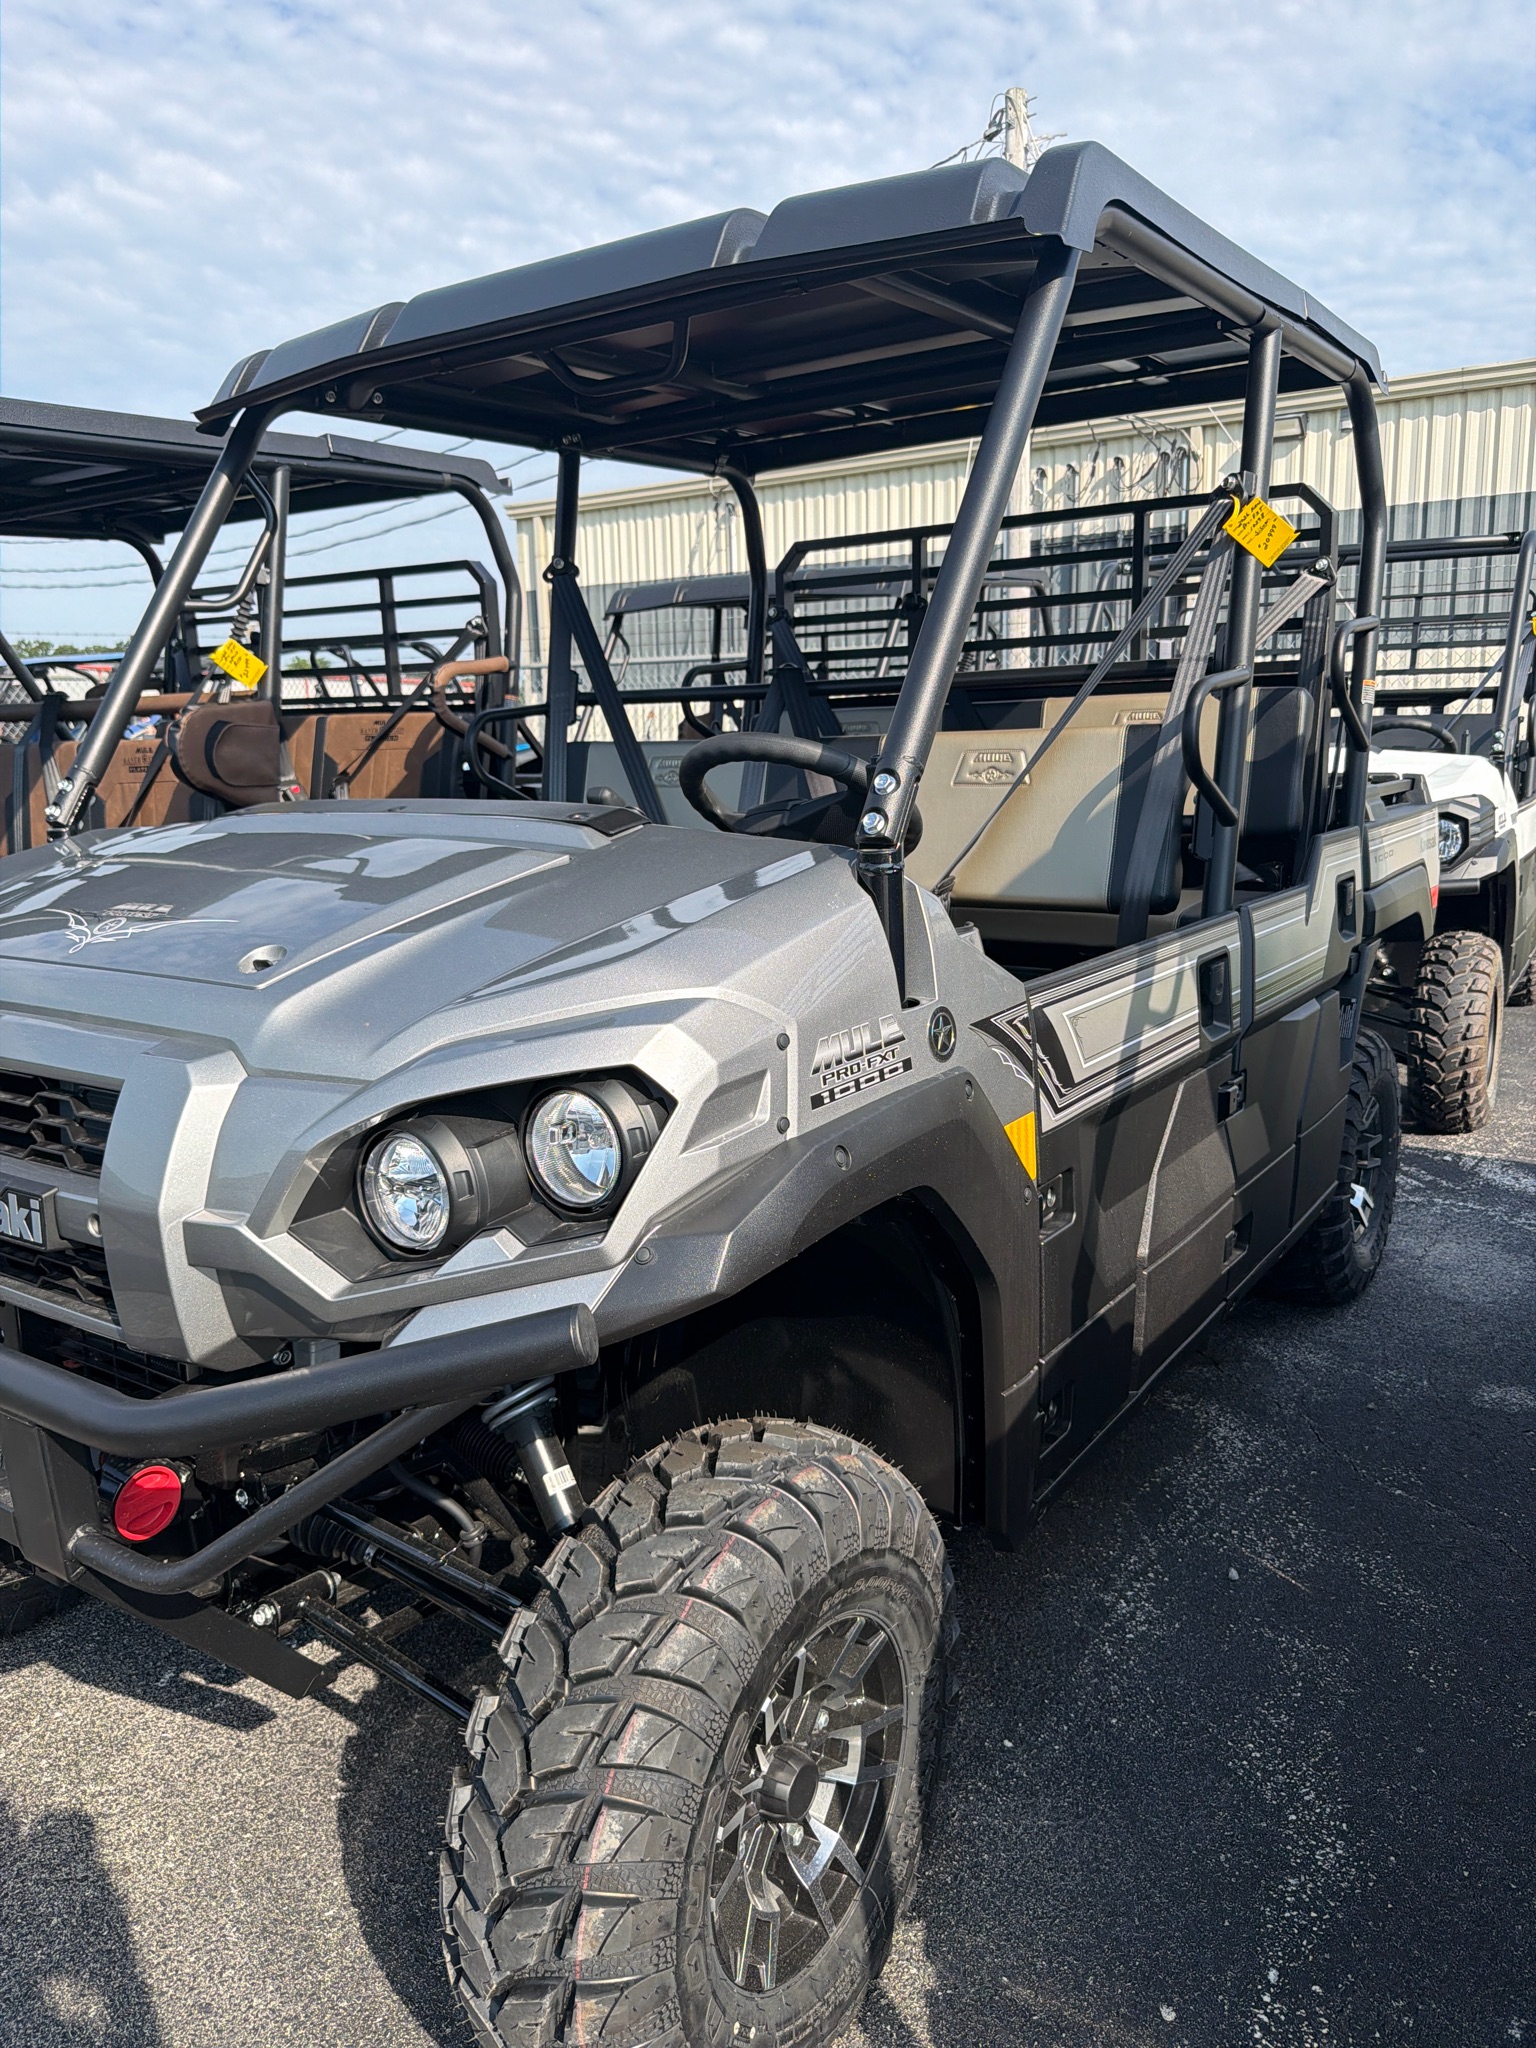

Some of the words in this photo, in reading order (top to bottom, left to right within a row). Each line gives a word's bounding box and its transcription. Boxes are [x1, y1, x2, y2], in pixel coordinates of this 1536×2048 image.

[810, 1013, 906, 1076] MULE
[819, 1061, 904, 1105] 1000
[820, 1046, 899, 1089] PRO-FXT
